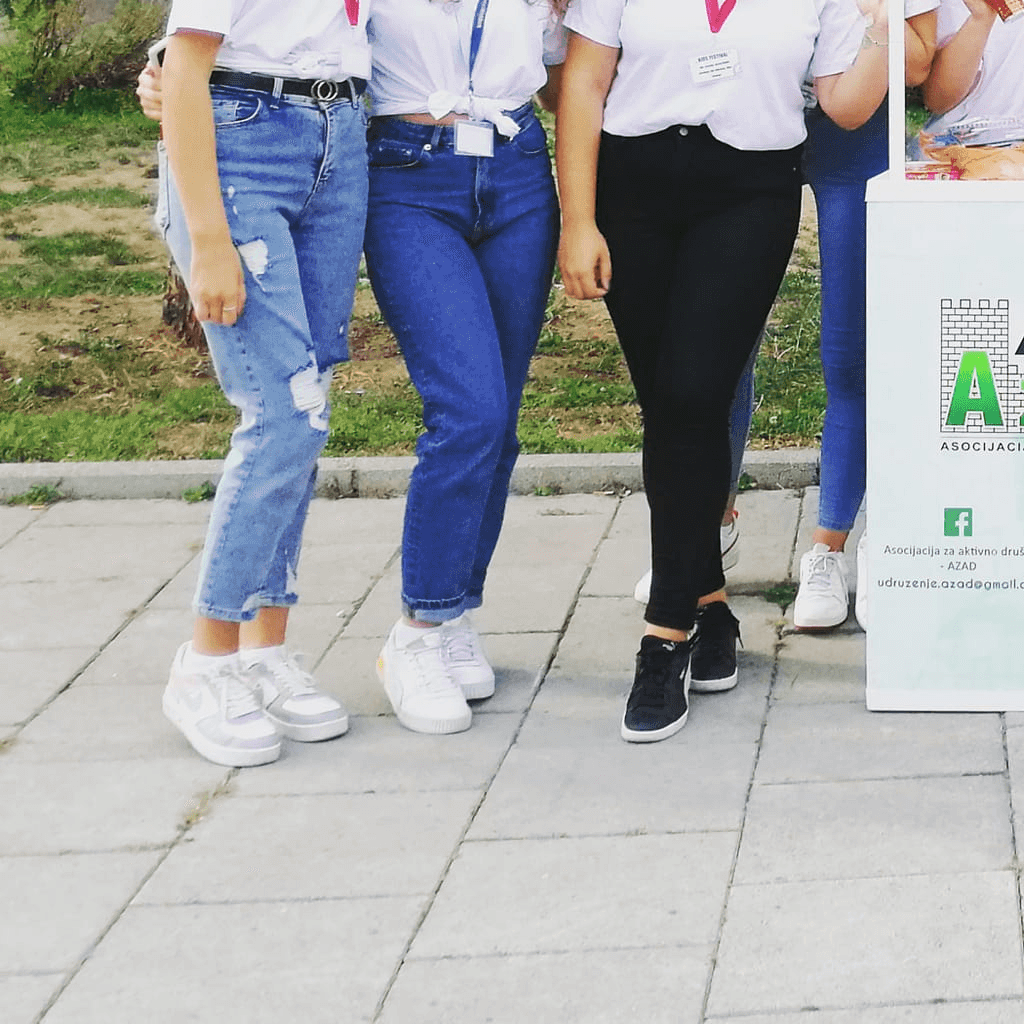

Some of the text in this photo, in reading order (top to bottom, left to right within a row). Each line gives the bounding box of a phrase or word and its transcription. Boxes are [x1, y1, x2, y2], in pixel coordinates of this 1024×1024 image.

[883, 545, 940, 557] Asocijacija
[943, 547, 955, 556] za
[958, 546, 998, 557] aktivno
[947, 561, 977, 571] AZAD
